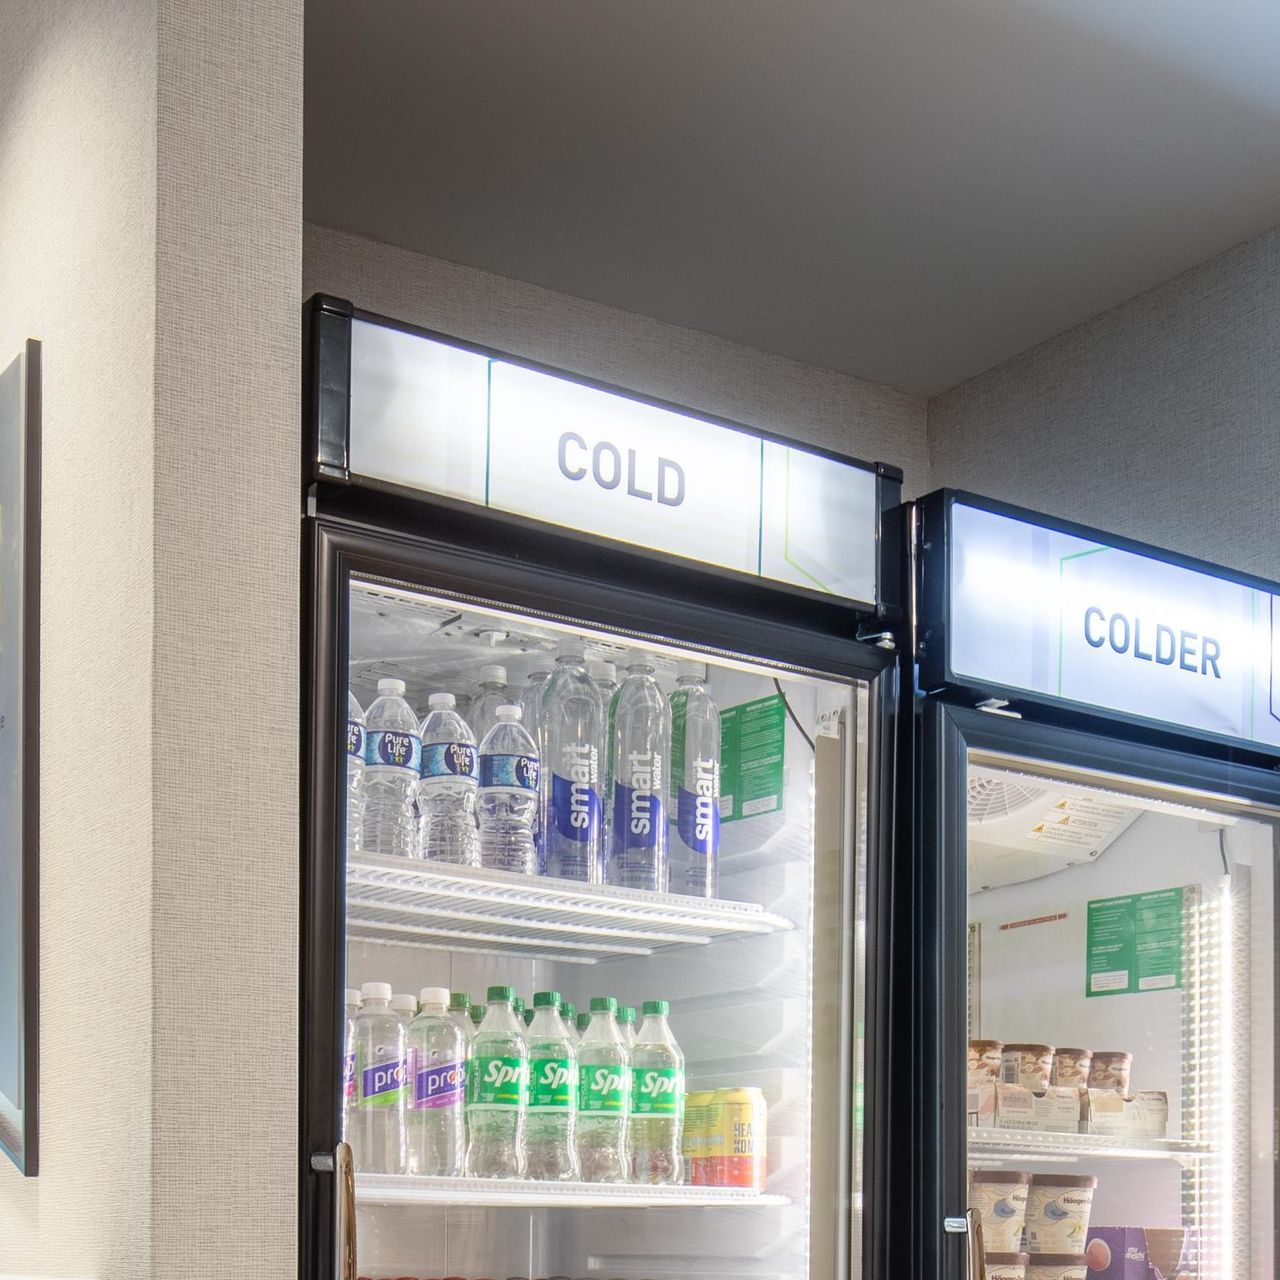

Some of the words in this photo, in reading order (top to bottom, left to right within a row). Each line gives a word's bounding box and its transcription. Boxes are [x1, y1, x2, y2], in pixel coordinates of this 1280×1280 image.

[557, 430, 687, 508] COLD
[1083, 604, 1222, 680] COLDER
[384, 733, 410, 748] Pure
[387, 743, 407, 757] Life
[450, 743, 473, 756] Pure
[453, 753, 471, 766] Life
[589, 744, 598, 784] water
[652, 752, 663, 790] water
[570, 743, 590, 829] smart
[630, 750, 651, 835] smart
[692, 757, 714, 841] smart
